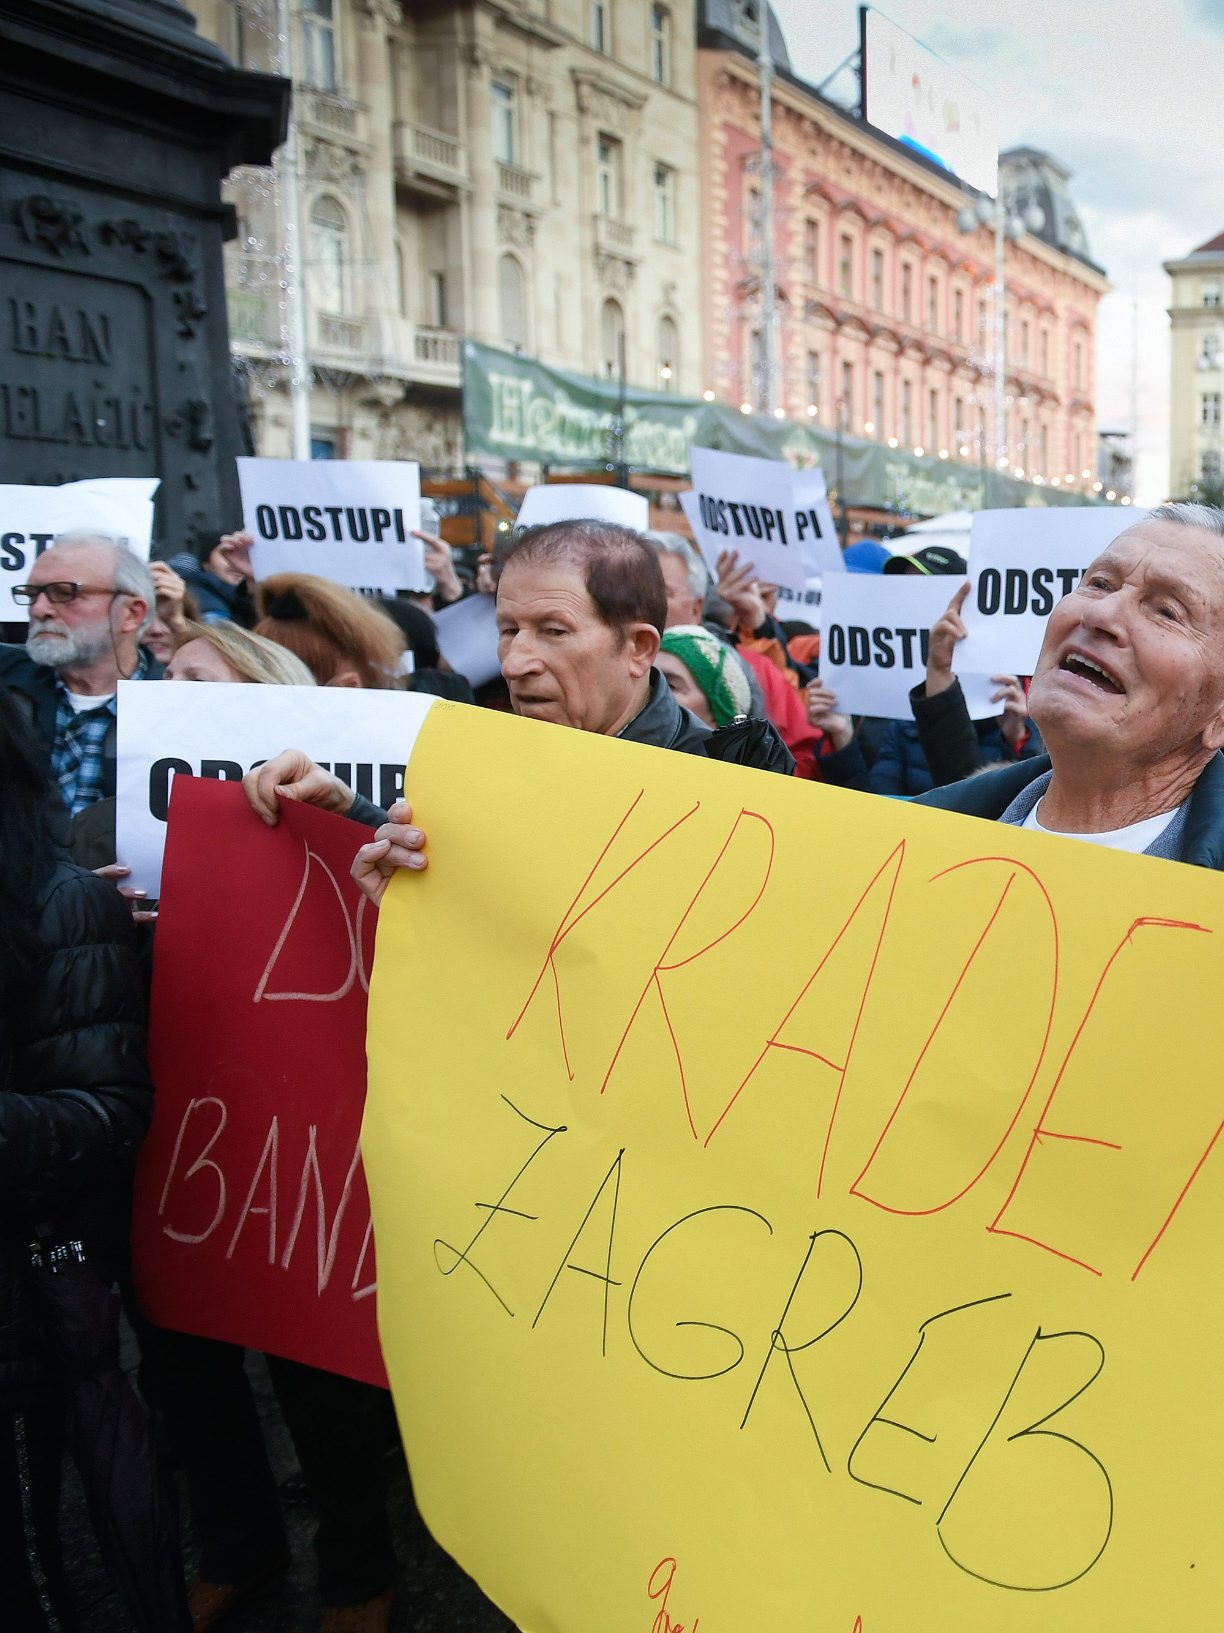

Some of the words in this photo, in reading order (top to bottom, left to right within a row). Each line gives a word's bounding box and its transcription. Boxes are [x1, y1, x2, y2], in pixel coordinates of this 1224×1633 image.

[256, 504, 407, 544] ODSTUPI
[977, 567, 1088, 616] ODST
[432, 1093, 1114, 1592] ZAGREB
